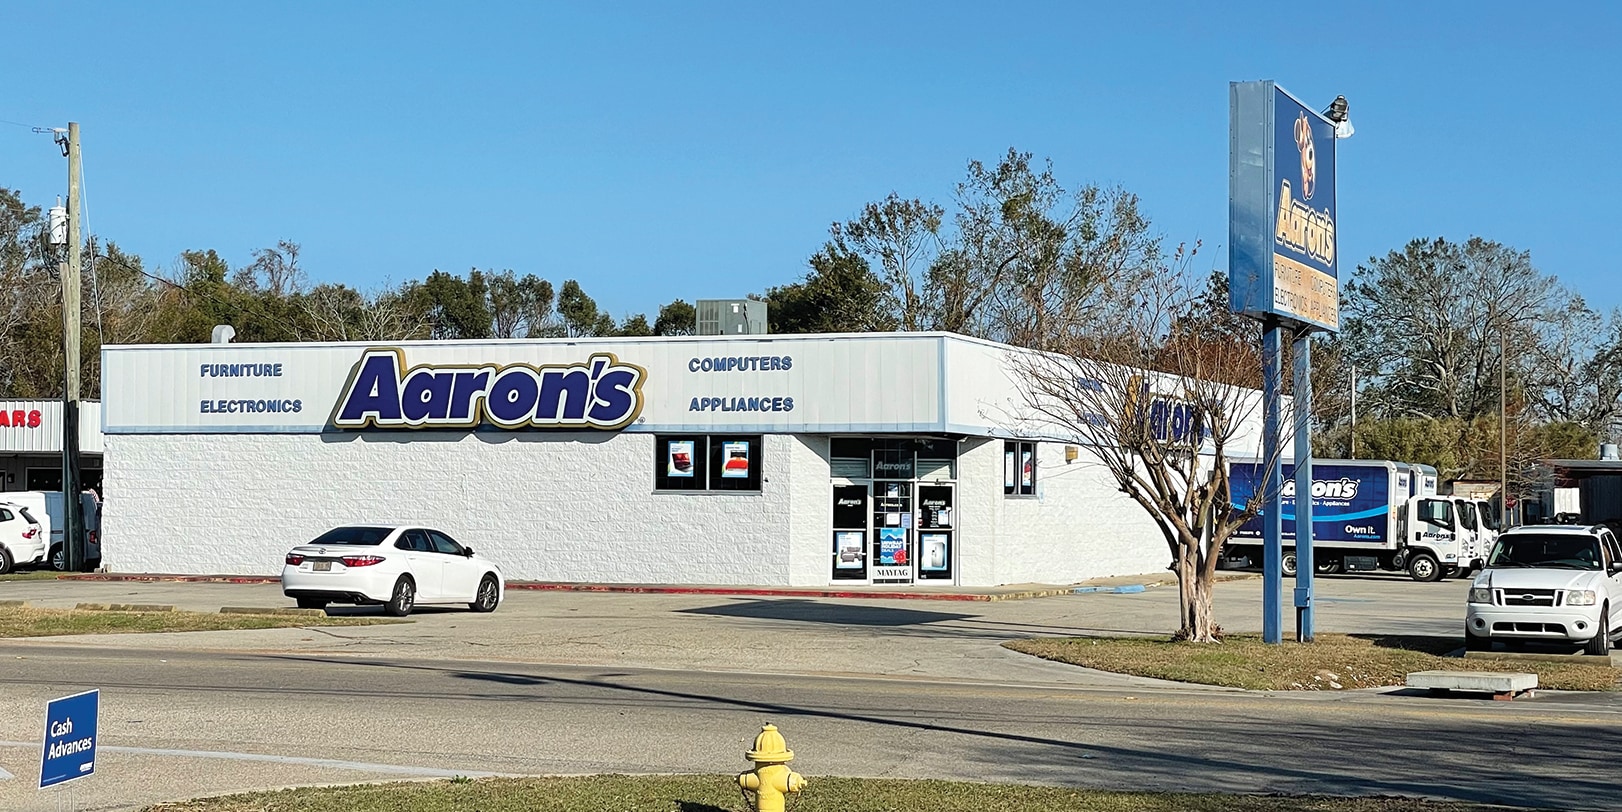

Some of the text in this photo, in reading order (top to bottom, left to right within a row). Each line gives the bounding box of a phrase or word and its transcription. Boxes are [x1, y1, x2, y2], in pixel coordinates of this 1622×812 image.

[1275, 179, 1334, 266] Aaron's
[200, 363, 283, 377] FURNITURE
[688, 356, 793, 373] COMPUTERS
[339, 355, 637, 421] Aaron's
[200, 399, 302, 413] ELECTRONICS
[689, 397, 794, 412] APPLIANCES
[875, 461, 912, 471] Aaron's
[1281, 477, 1356, 499] aon's
[1345, 525, 1367, 534] Own
[50, 717, 73, 738] Cash
[48, 737, 92, 760] Advances
